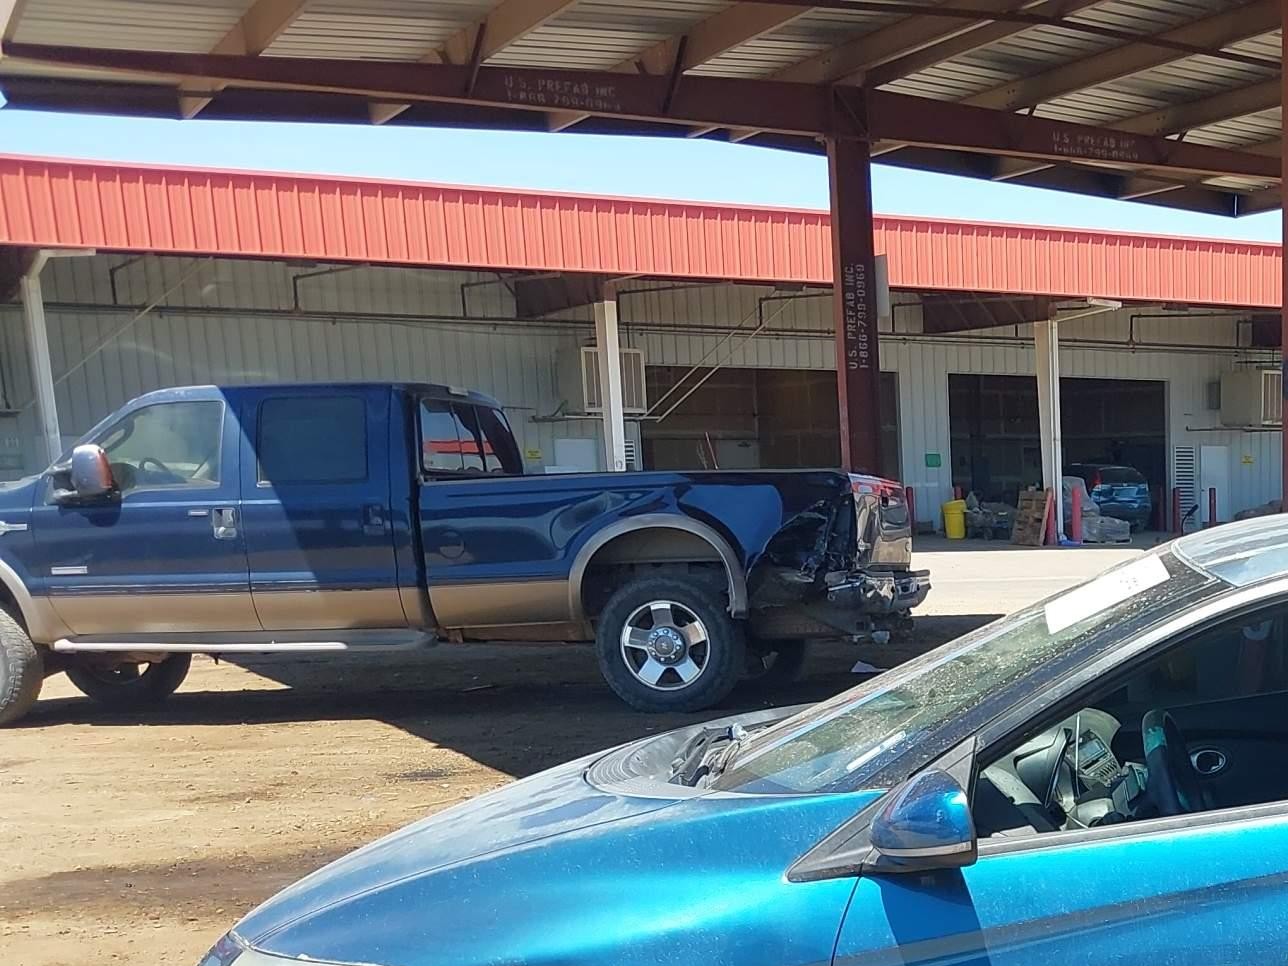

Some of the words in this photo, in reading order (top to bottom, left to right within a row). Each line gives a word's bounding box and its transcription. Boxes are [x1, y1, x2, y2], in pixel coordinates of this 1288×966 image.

[846, 292, 856, 340] PREFAB
[856, 264, 868, 369] 1-866-799-0969
[848, 346, 858, 369] U.S.
